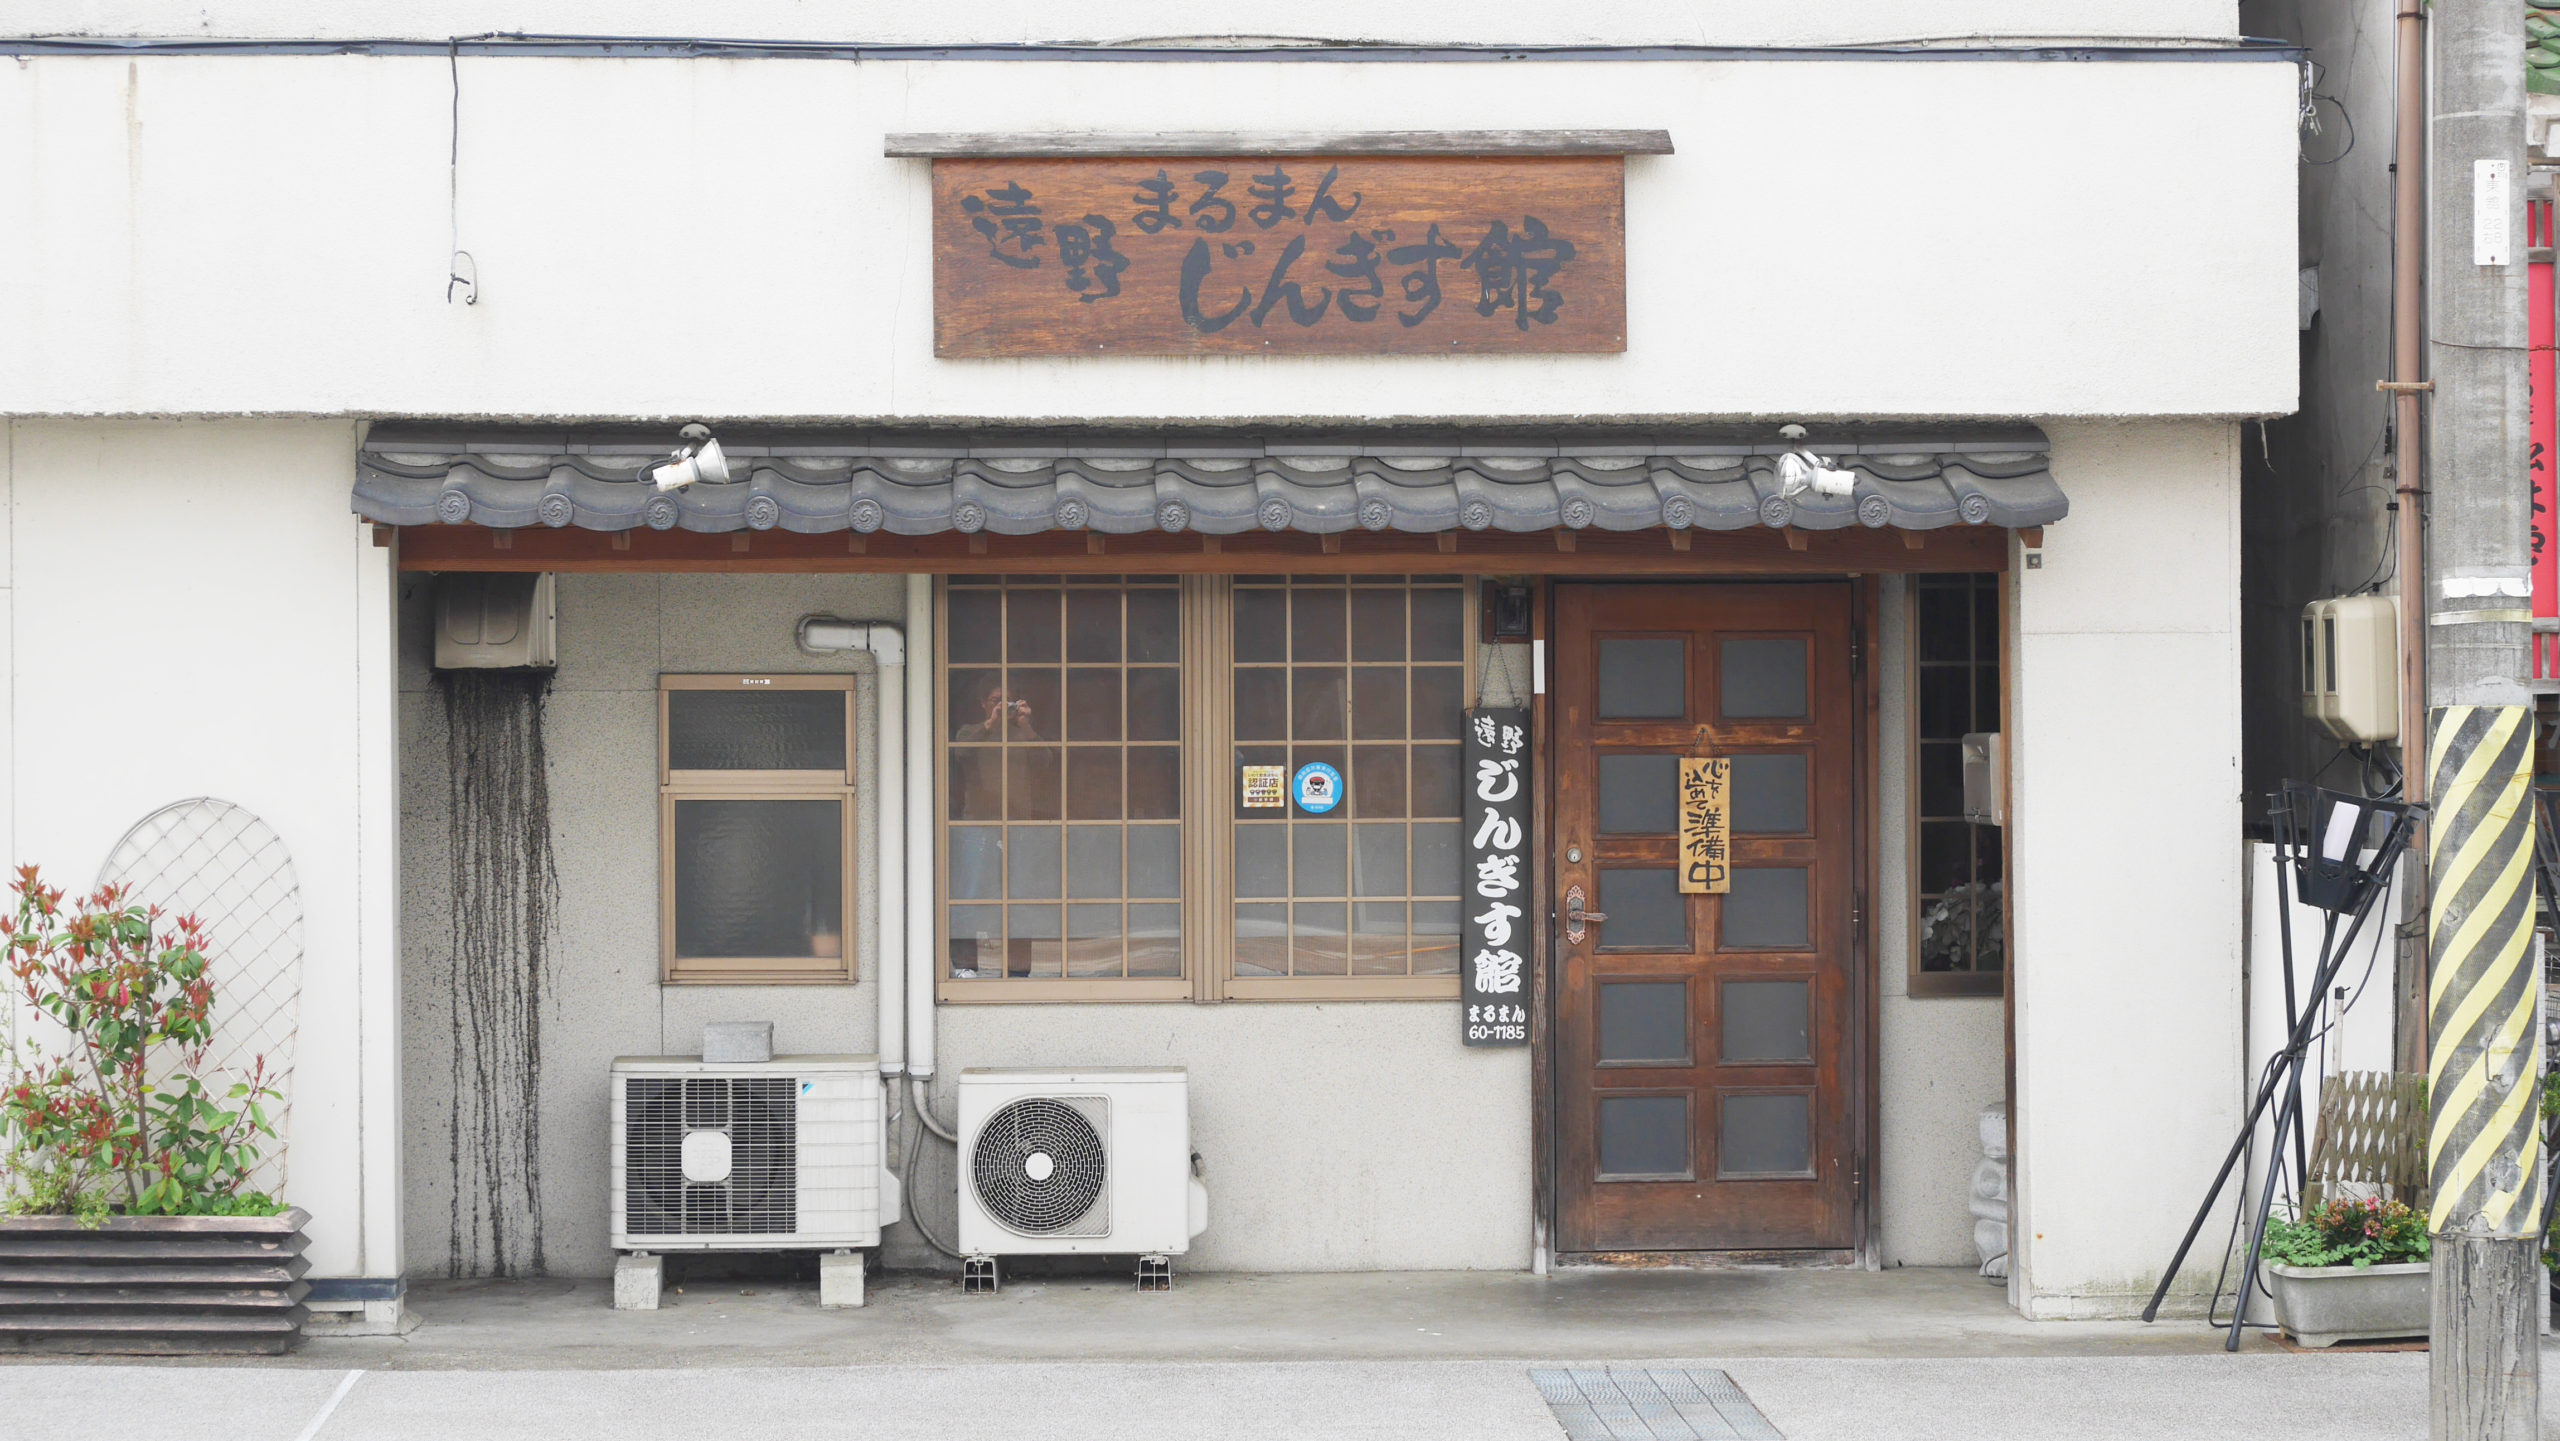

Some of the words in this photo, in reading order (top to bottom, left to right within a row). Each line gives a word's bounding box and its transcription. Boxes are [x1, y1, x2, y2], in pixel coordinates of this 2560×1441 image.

[1132, 163, 1361, 235] まるまん
[961, 179, 1131, 302] 遠野
[1179, 214, 1578, 331] じんぎす館
[1474, 714, 1524, 754] 遠野
[1248, 777, 1279, 788] 認証店
[1684, 770, 1708, 810] 込めて
[1703, 760, 1729, 799] 心を
[1684, 807, 1726, 890] 準備中
[1473, 758, 1523, 994] じんぎす館
[1469, 1004, 1526, 1023] まるまん
[1469, 1025, 1525, 1040] 60-1185
